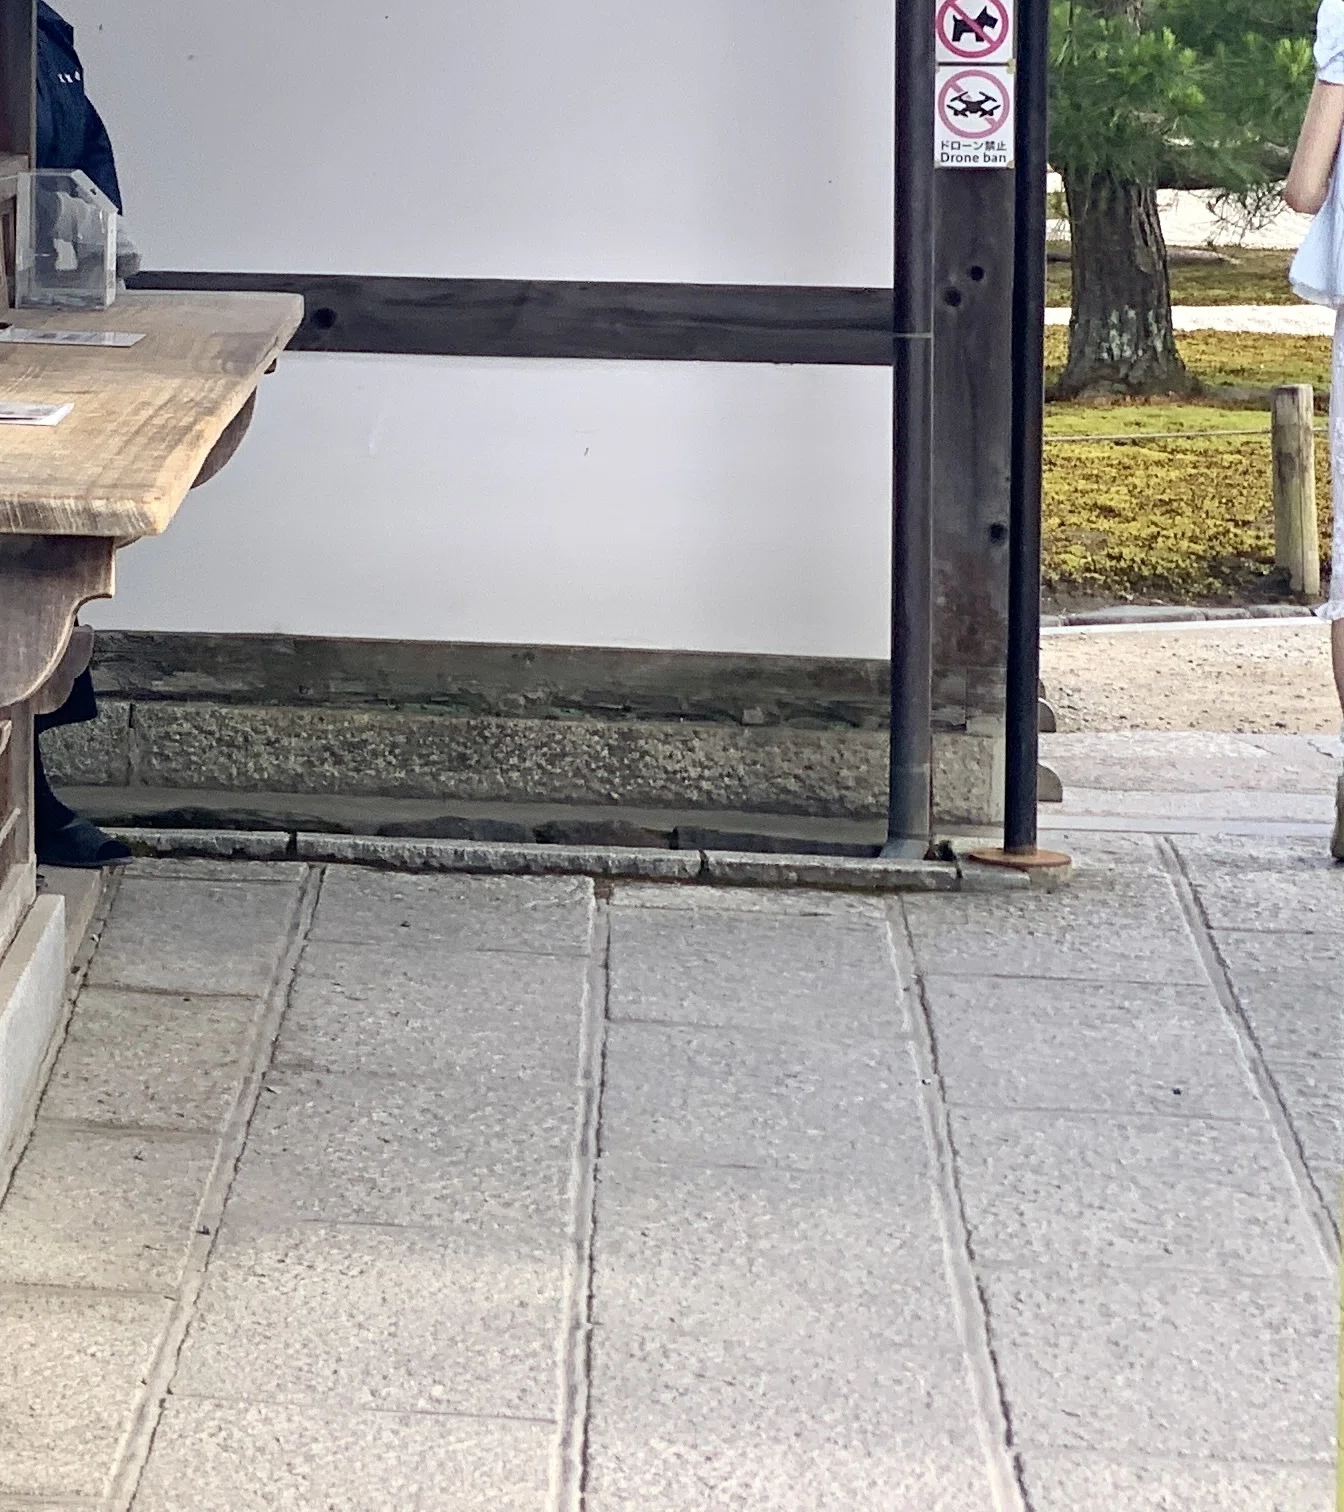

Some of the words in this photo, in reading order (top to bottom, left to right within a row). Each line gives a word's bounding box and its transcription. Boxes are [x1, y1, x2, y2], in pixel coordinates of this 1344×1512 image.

[941, 140, 1007, 151] ドローン禁止
[941, 152, 980, 163] Drone
[983, 152, 1007, 163] ban
